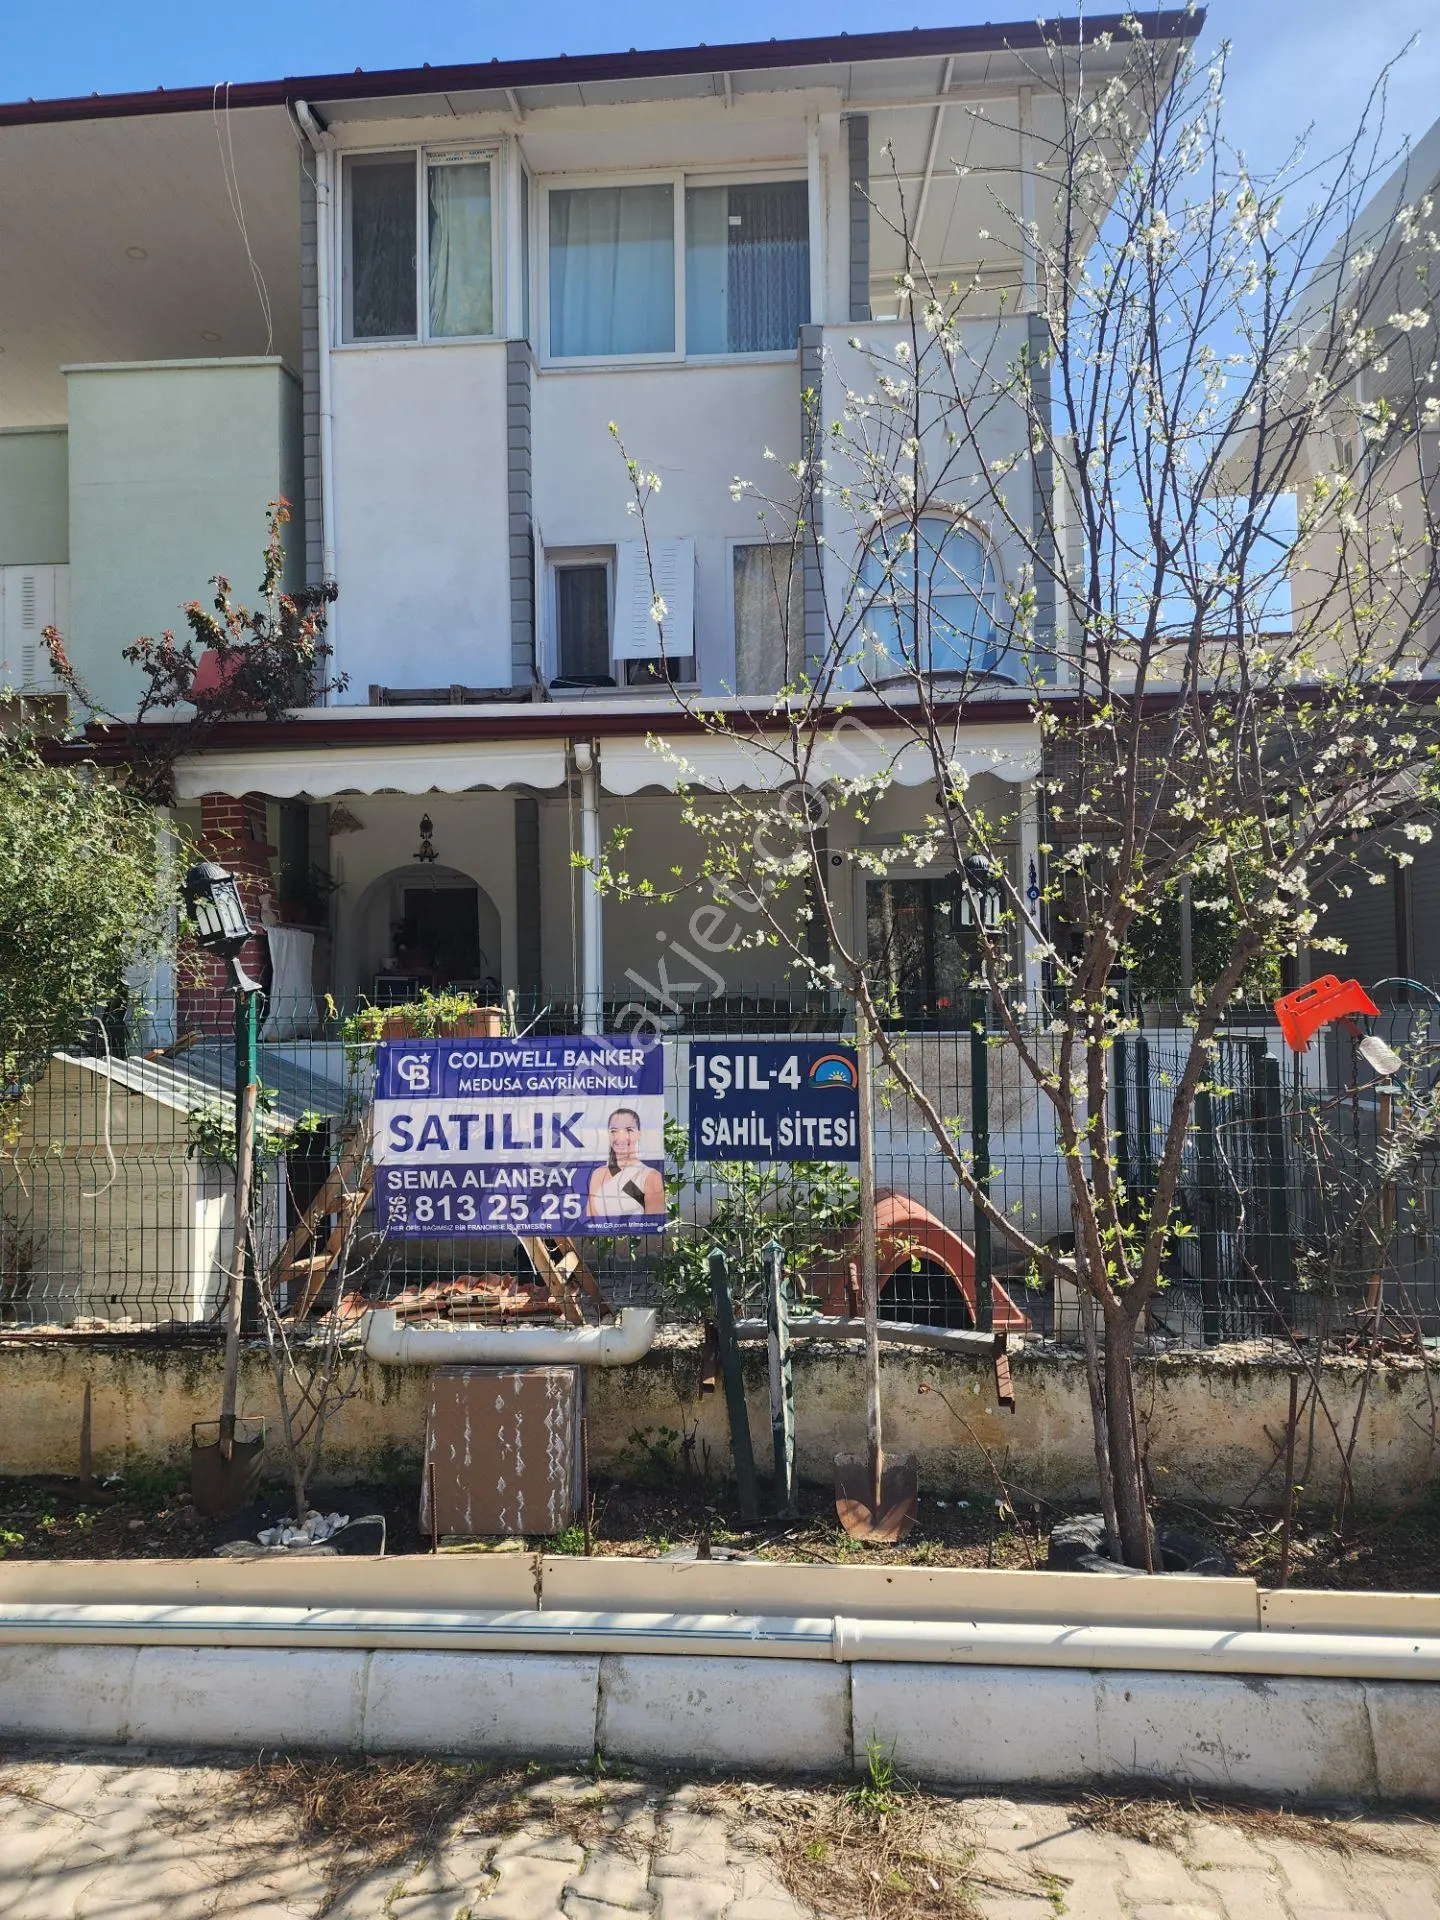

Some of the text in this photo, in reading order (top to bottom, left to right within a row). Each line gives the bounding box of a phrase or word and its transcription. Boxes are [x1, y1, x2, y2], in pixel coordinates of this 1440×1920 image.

[448, 1049, 645, 1069] COLDWELL BANKER
[459, 1073, 638, 1092] MEDUSA GAYRİMENKUL
[696, 1055, 801, 1099] IŞIL-4
[389, 1112, 587, 1152] SATILIK
[701, 1110, 856, 1146] SAHİL SİTESİ
[387, 1168, 578, 1190] SEMA ALANBAY
[415, 1193, 581, 1222] 813 25 25
[455, 1223, 466, 1231] BİR
